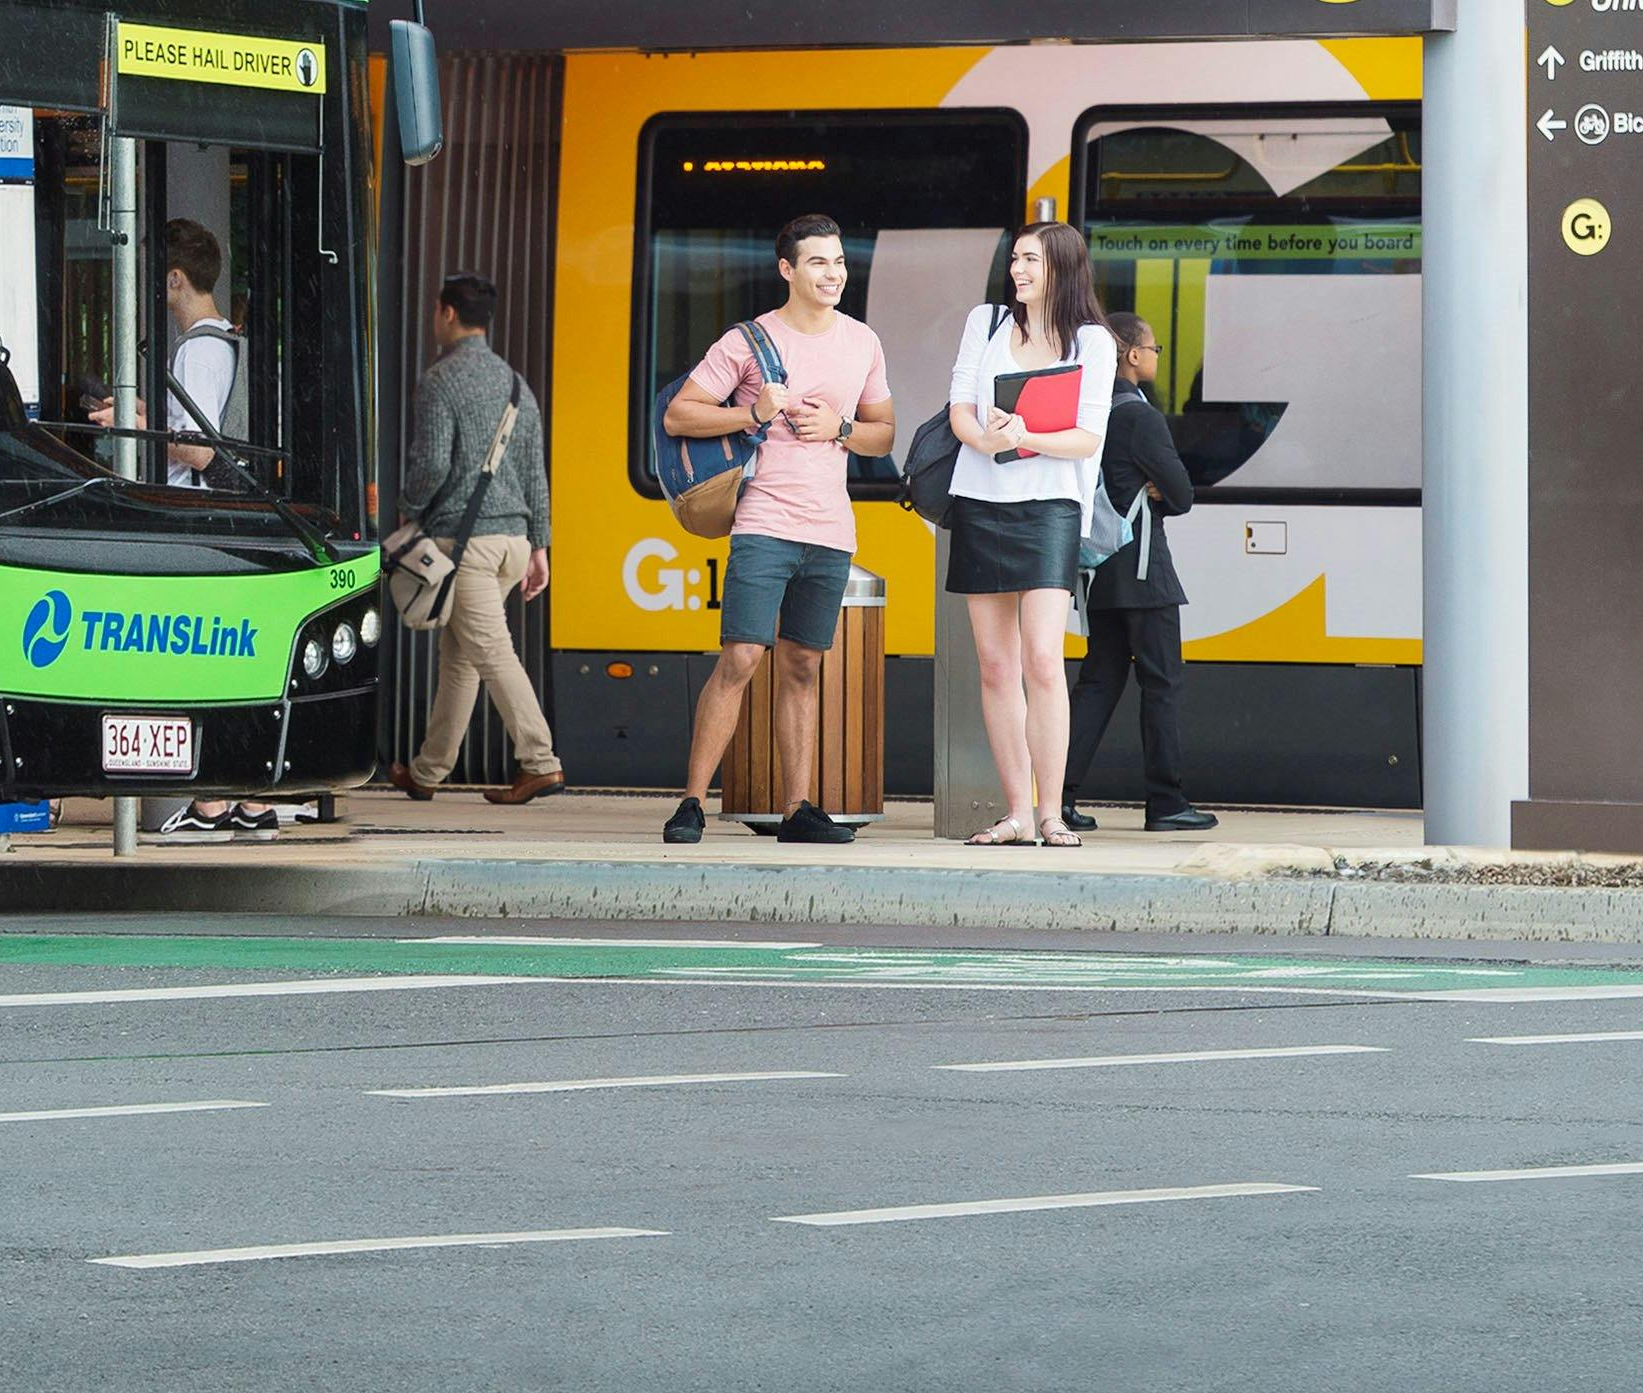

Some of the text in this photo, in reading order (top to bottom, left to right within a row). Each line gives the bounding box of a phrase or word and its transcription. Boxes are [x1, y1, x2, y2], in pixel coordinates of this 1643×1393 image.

[124, 39, 292, 76] PLEASE HAIL DRIVER
[1579, 49, 1643, 73] Griffith
[1097, 233, 1414, 255] Touch on every time before you board
[329, 568, 356, 589] 390
[81, 610, 258, 657] TRANSLink
